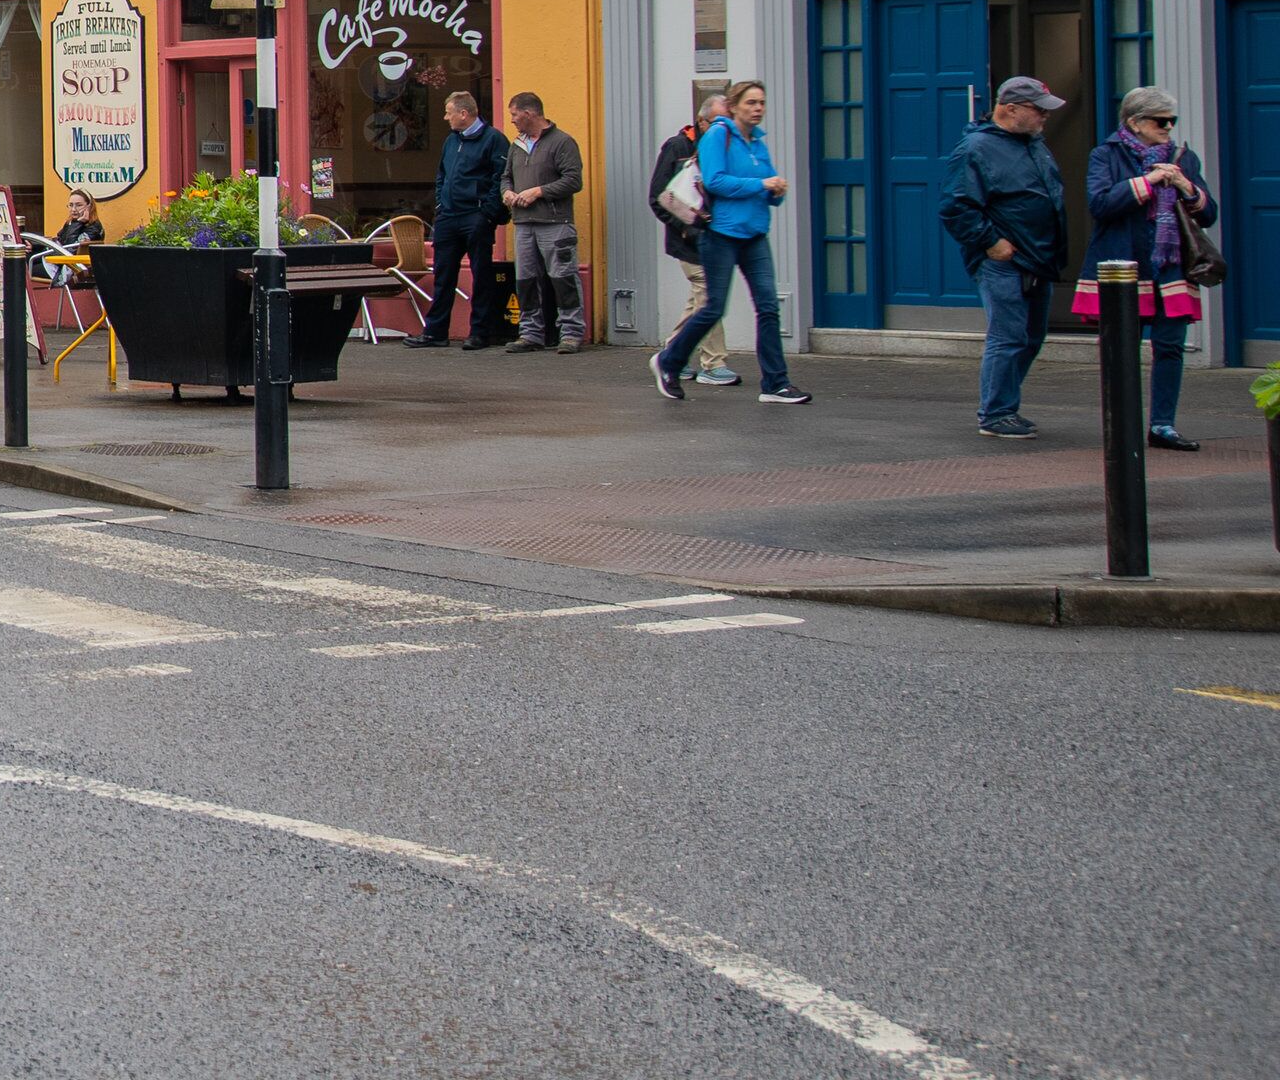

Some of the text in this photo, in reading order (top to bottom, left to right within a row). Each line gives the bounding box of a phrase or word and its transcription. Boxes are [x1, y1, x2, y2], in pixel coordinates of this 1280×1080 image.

[77, 1, 114, 15] FULL
[55, 16, 138, 43] IRISH BREAKFAST
[62, 38, 132, 56] Served until Lunch
[72, 58, 117, 69] HOMEMADE
[62, 67, 129, 95] SOUP
[58, 102, 137, 126] SMOOTHIES
[72, 126, 131, 152] MILKSHAKES
[210, 144, 225, 153] OPEN
[72, 159, 115, 170] Homemade
[63, 167, 135, 184] ICE CREAM
